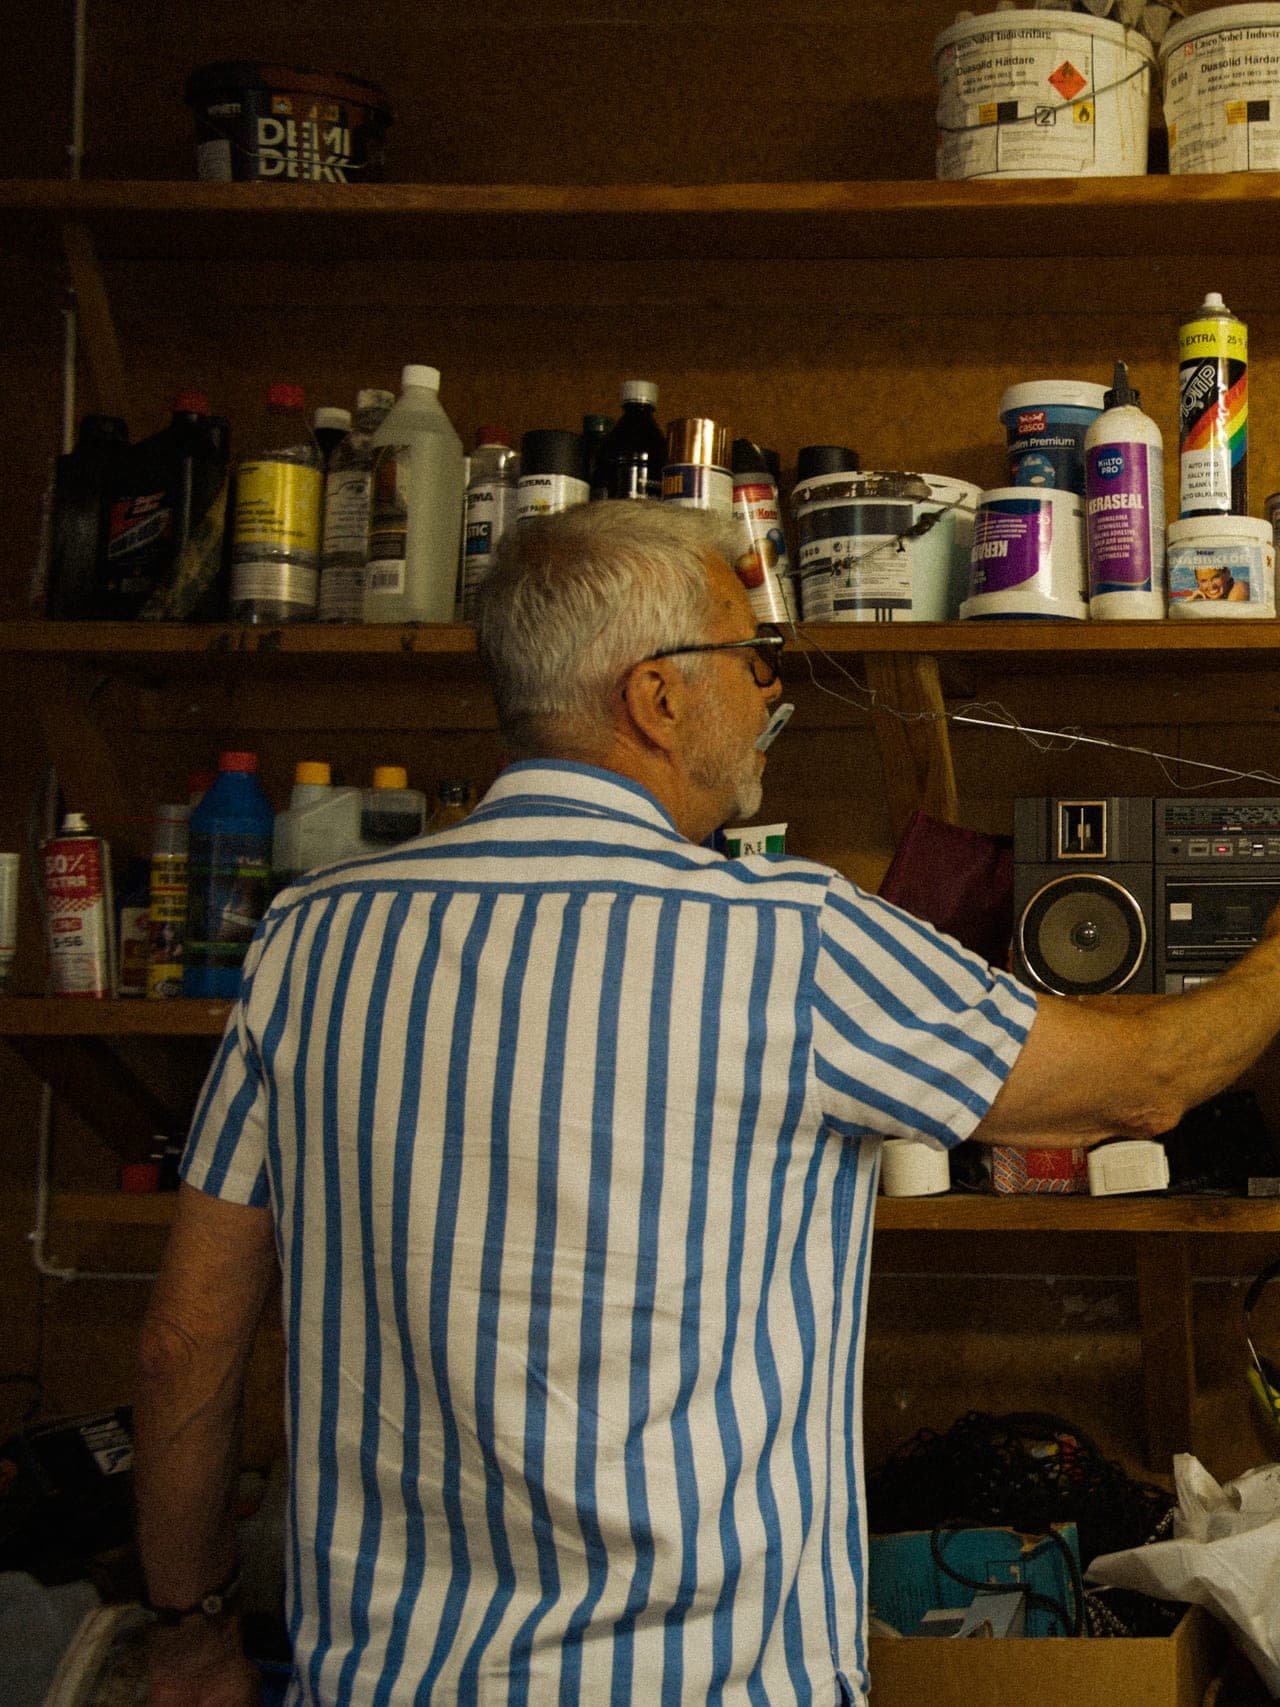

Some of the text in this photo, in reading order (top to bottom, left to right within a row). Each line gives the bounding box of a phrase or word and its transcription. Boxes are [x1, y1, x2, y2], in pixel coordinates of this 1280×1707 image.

[1040, 109, 1051, 124] 2
[1186, 334, 1216, 346] EXTRA
[1029, 436, 1075, 447] Premium
